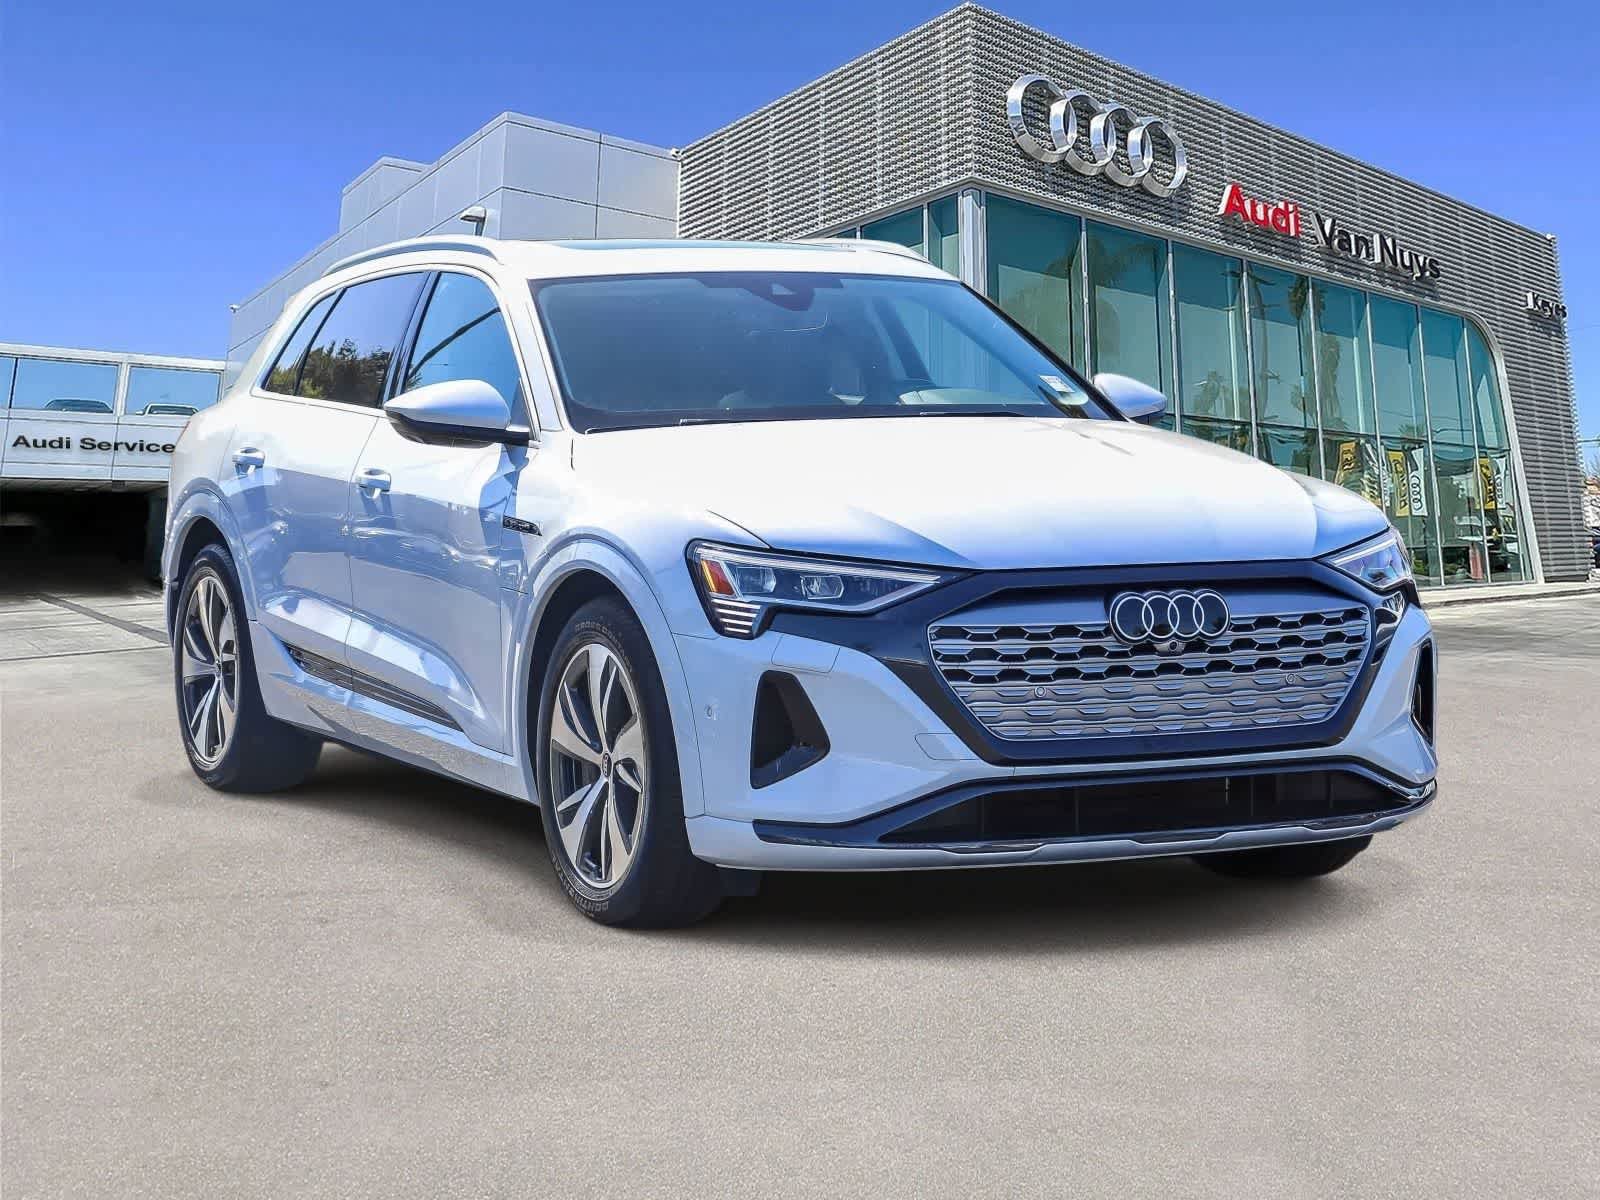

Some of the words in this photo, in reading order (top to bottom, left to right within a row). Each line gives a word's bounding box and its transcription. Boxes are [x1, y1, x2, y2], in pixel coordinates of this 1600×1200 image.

[1218, 183, 1301, 237] Audi
[1311, 212, 1373, 259] Van
[1374, 233, 1441, 281] Nuys
[1527, 292, 1567, 318] Keyes
[12, 434, 71, 450] Audi
[79, 437, 177, 454] Service
